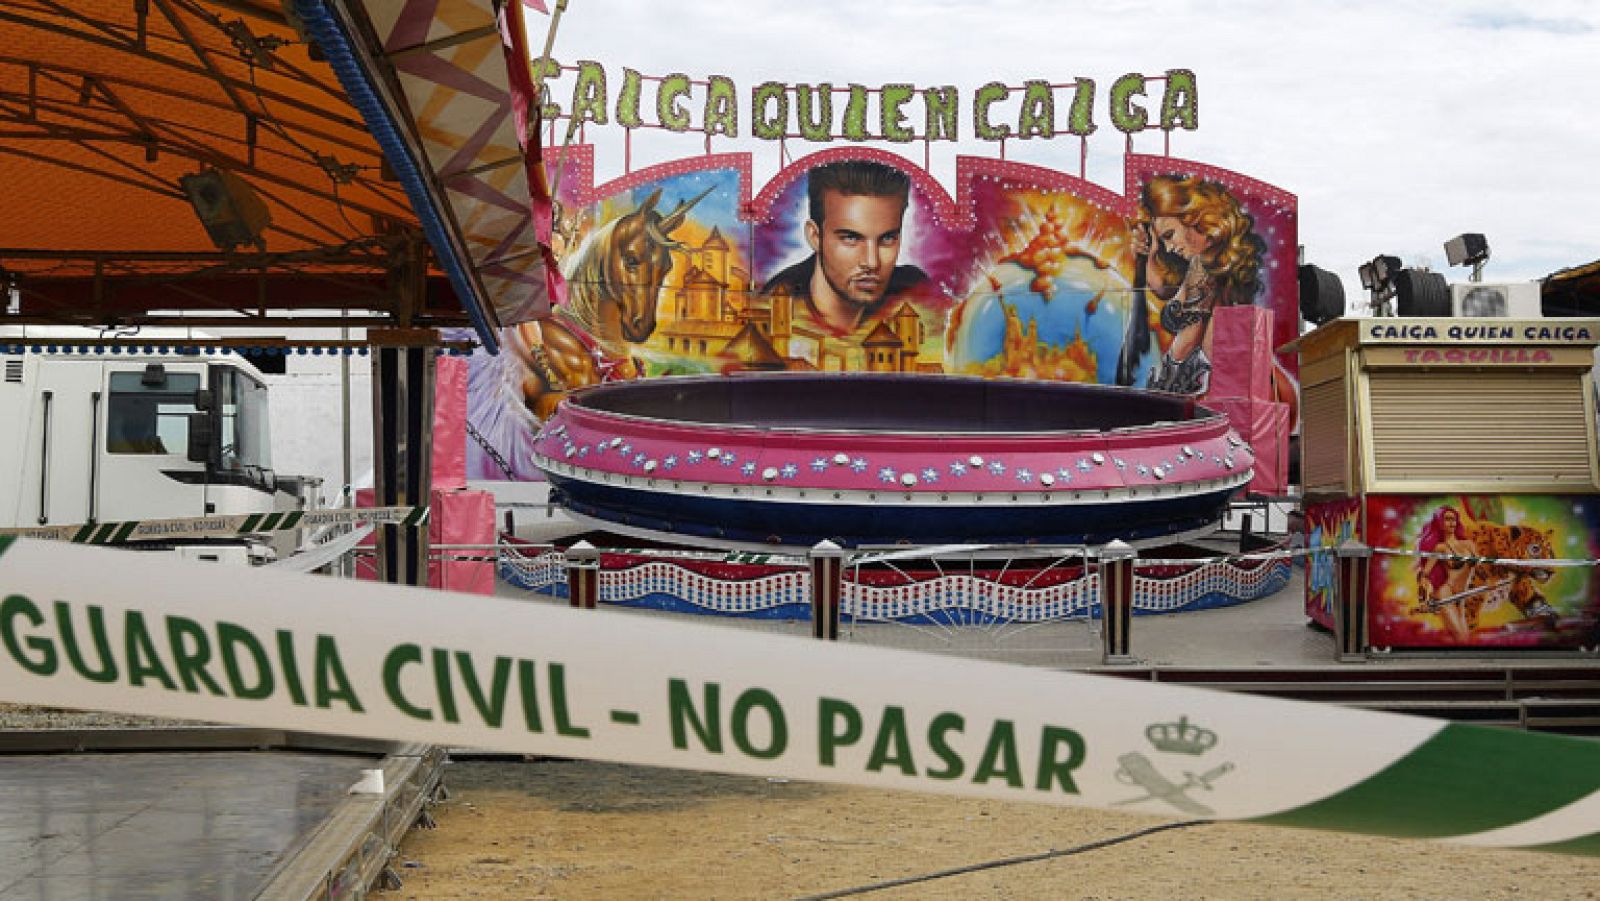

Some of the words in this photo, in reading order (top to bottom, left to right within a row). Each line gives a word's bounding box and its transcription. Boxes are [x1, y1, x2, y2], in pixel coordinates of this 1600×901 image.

[530, 57, 738, 137] CAIGA
[752, 82, 959, 142] QUIEN
[974, 69, 1199, 139] CAIGA
[1370, 325, 1438, 340] CAIGA
[1447, 325, 1514, 340] QUIEN
[1524, 326, 1592, 341] CAIGA
[1404, 349, 1553, 363] TAQUILLA
[0, 594, 364, 713] GUARDIA
[382, 643, 590, 738] CIVIL
[668, 677, 788, 759] NO
[818, 697, 1088, 794] PASAR
